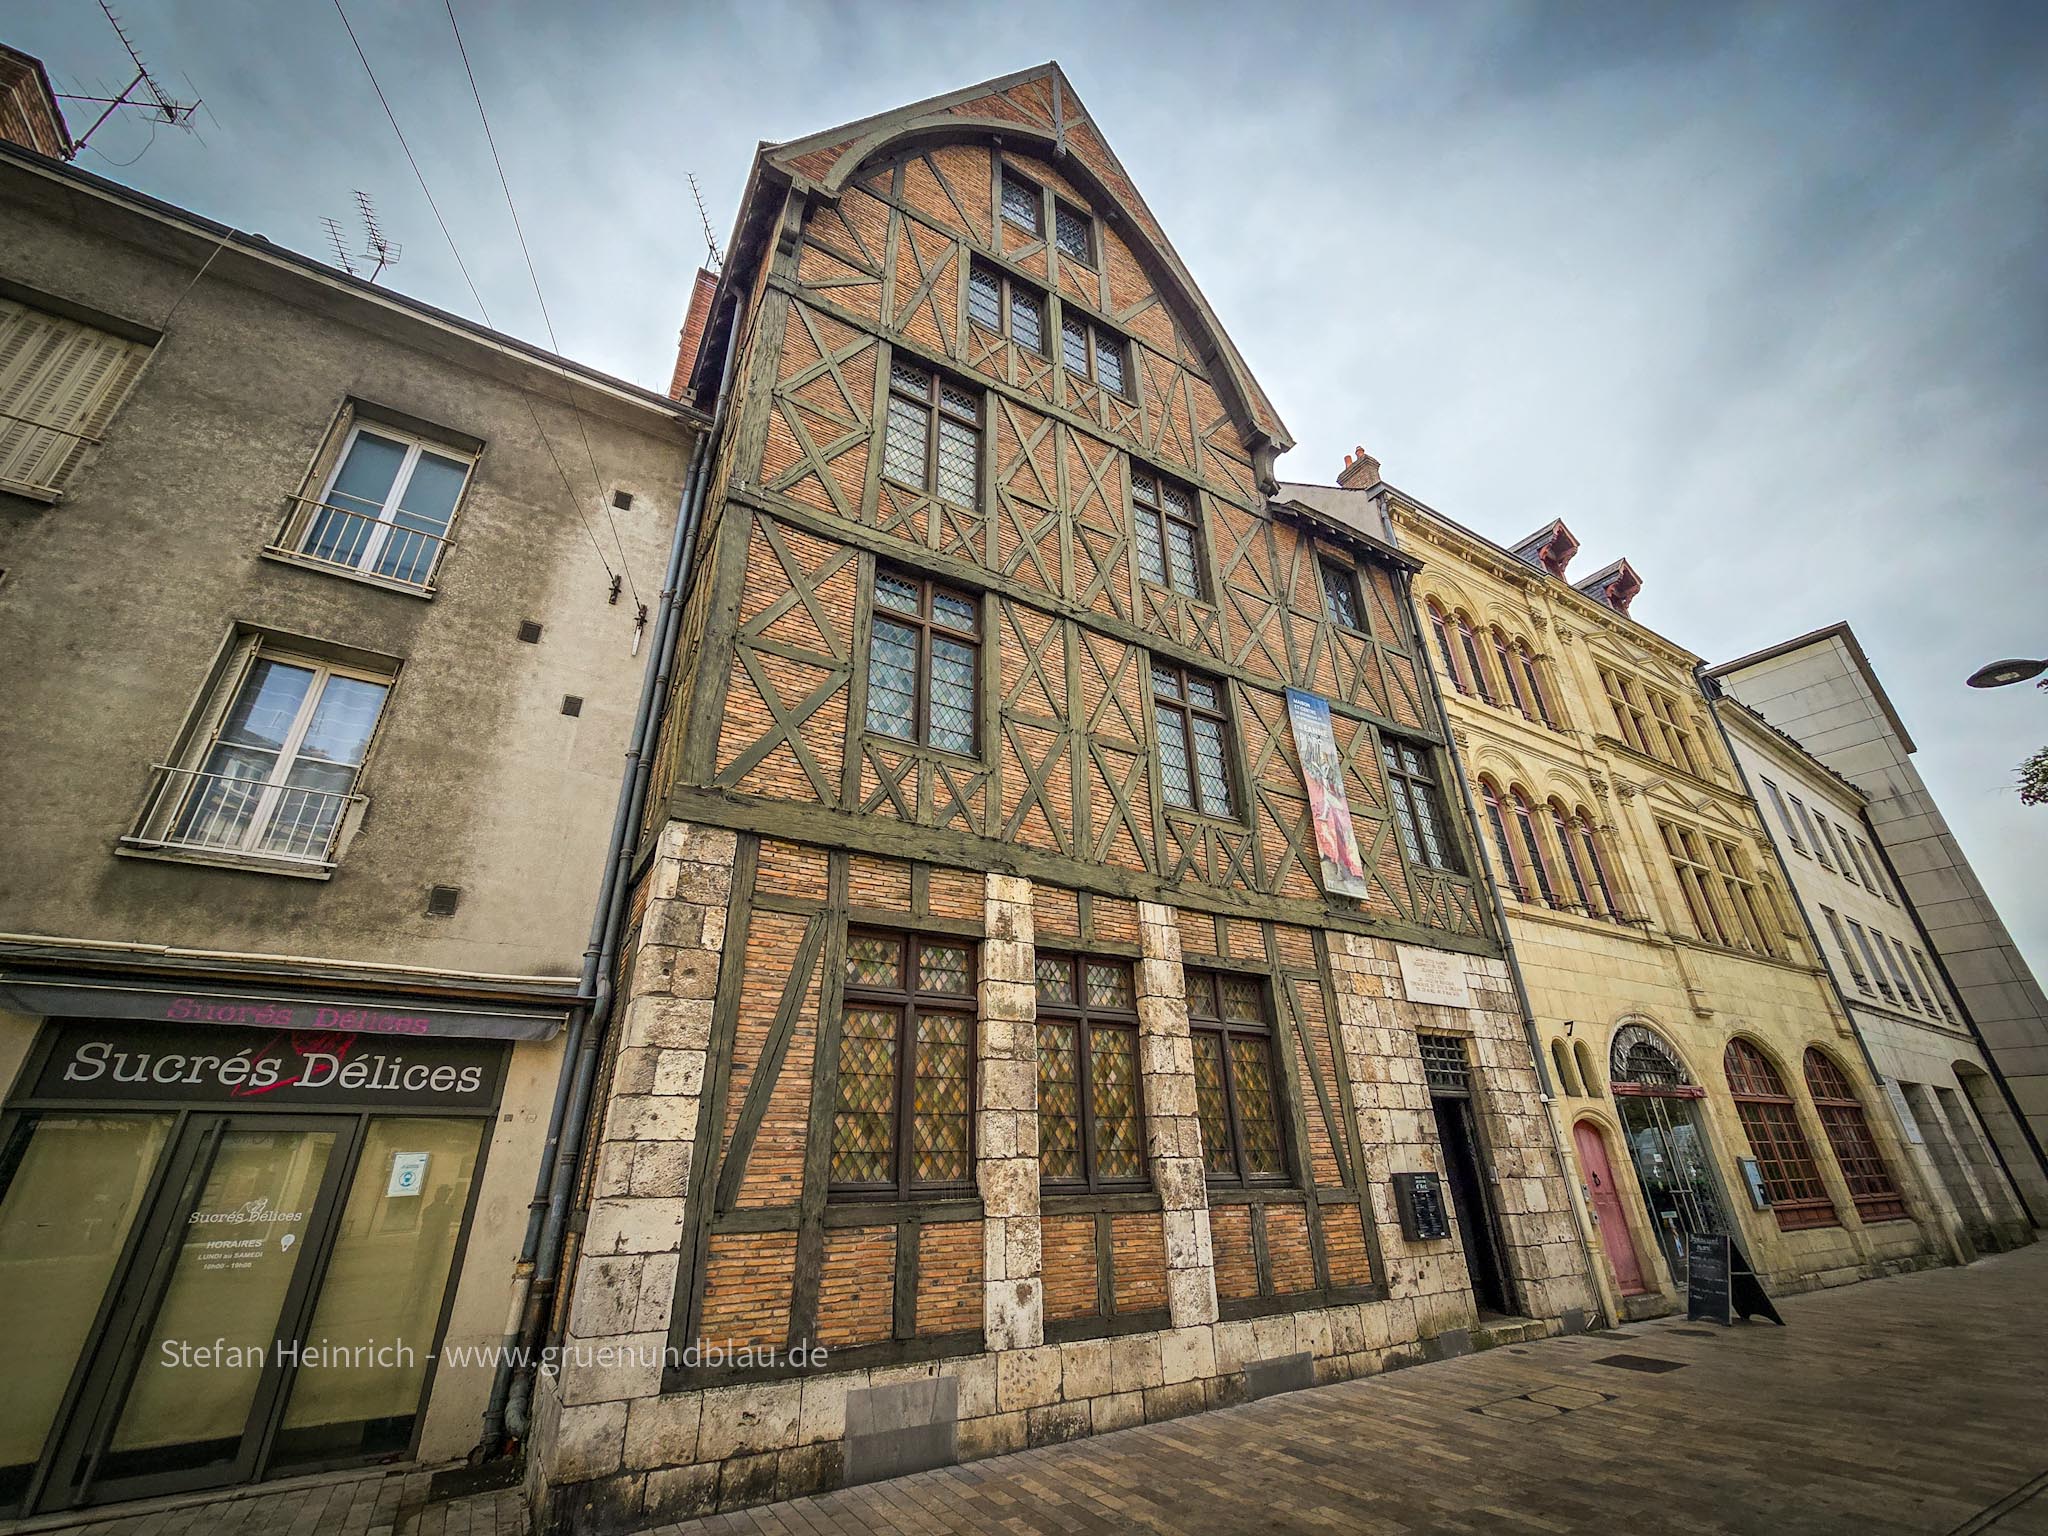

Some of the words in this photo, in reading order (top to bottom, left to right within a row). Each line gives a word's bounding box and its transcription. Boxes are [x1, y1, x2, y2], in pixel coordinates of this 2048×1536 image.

[167, 998, 293, 1026] Sucrés
[311, 1005, 430, 1035] Délices
[1564, 1020, 1574, 1037] 7
[64, 1042, 282, 1088] Sucrés
[293, 1052, 483, 1093] Délices
[188, 1211, 245, 1224] Sucrés
[248, 1210, 302, 1223] Délices
[206, 1239, 263, 1249] HORAIRES
